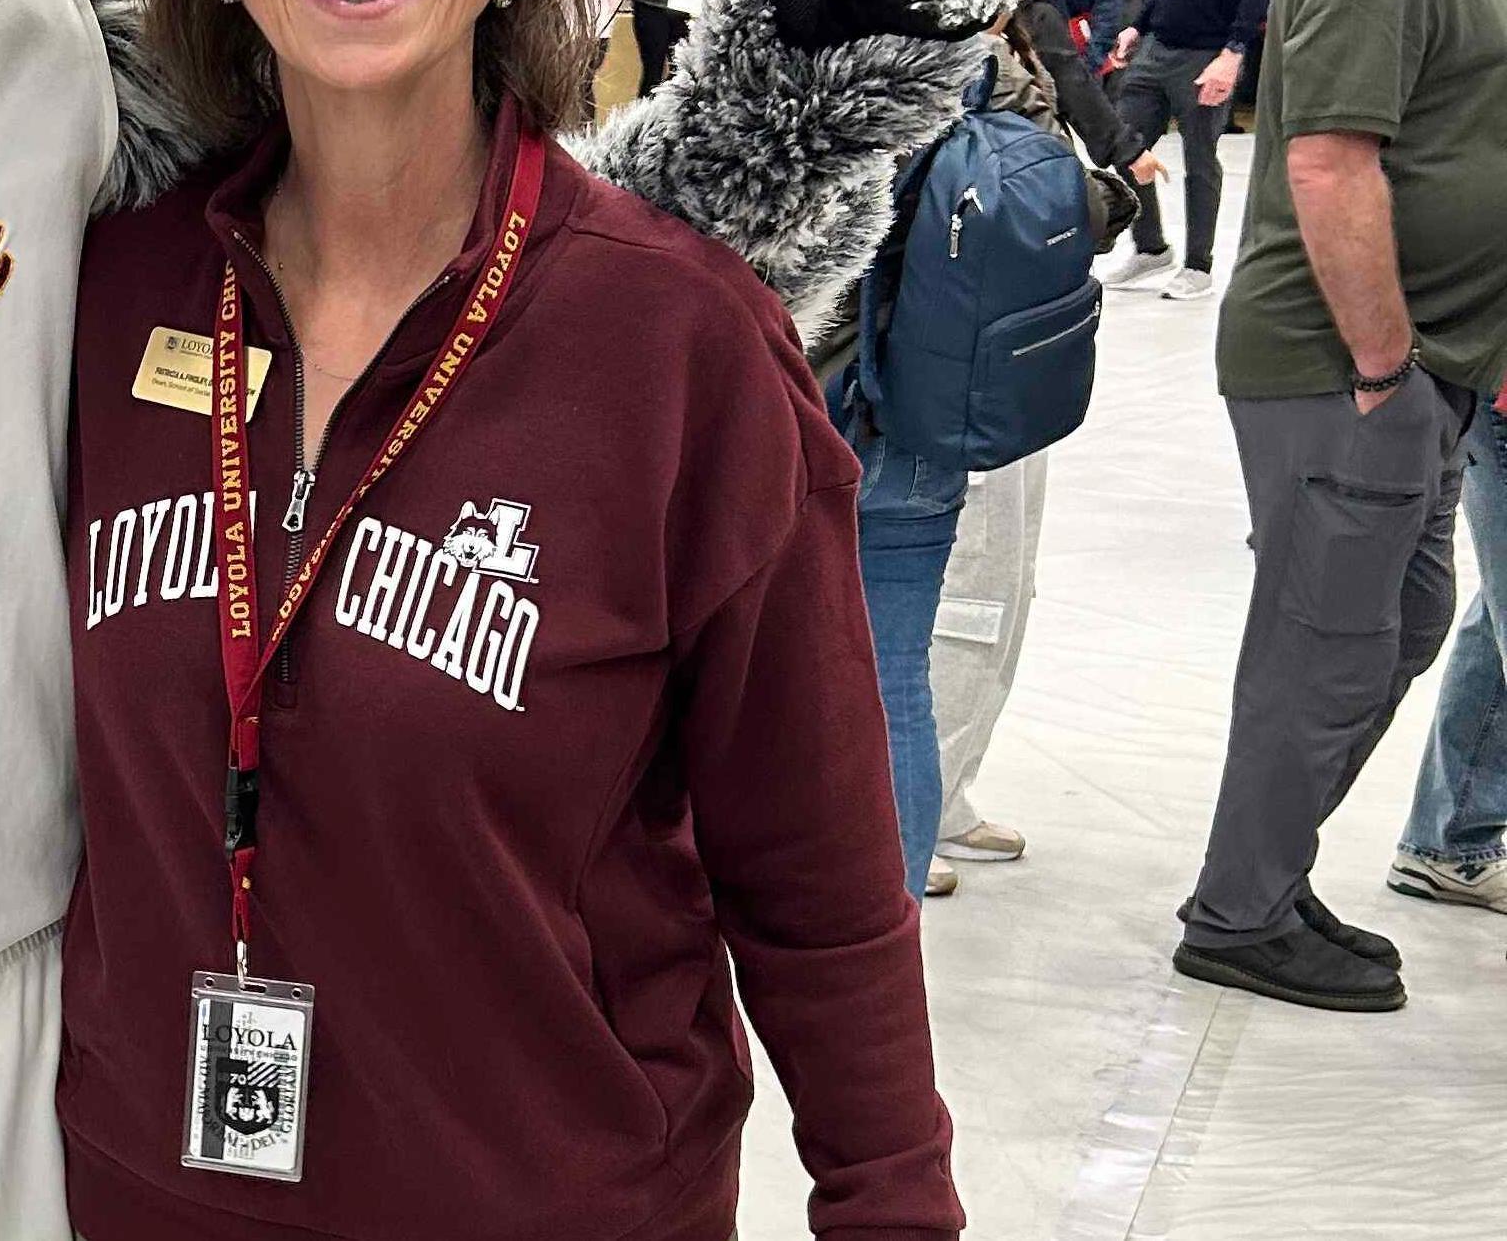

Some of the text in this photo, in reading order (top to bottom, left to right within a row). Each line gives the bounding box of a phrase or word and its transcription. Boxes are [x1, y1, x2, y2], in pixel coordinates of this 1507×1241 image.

[466, 211, 527, 324] LOYOLA
[180, 337, 213, 355] LOYO
[219, 330, 244, 513] UNIVERSITY
[86, 490, 540, 712] LOYOL CHICAGO
[226, 520, 253, 640] LOYOLA
[203, 1023, 297, 1051] LOYOLA
